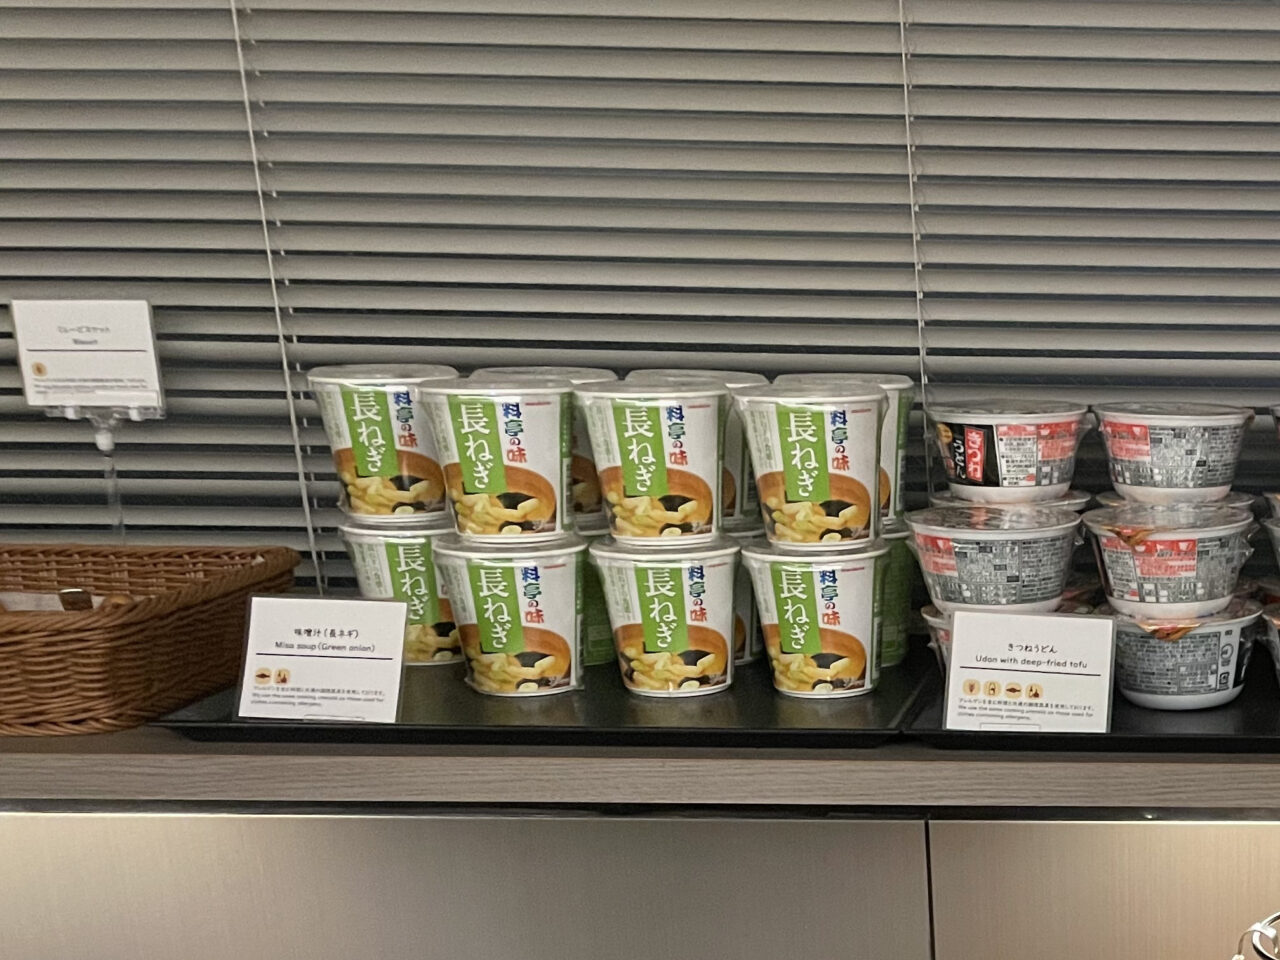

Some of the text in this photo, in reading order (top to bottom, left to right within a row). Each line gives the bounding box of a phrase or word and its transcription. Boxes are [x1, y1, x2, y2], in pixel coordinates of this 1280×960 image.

[351, 391, 386, 473] 長ねぎ
[457, 403, 494, 489] 長ねぎ
[622, 406, 656, 492] 長ねぎ
[785, 411, 819, 497] 長ねぎ
[397, 545, 430, 620] 長ねぎ
[476, 568, 512, 648] 長ねぎ
[643, 568, 676, 648] 長ねぎ
[780, 569, 809, 650] 長ねぎ
[275, 641, 295, 649] Miso
[975, 655, 1087, 669] Udon with deep-fried tofu
[1008, 643, 1058, 654] きつねうどん
